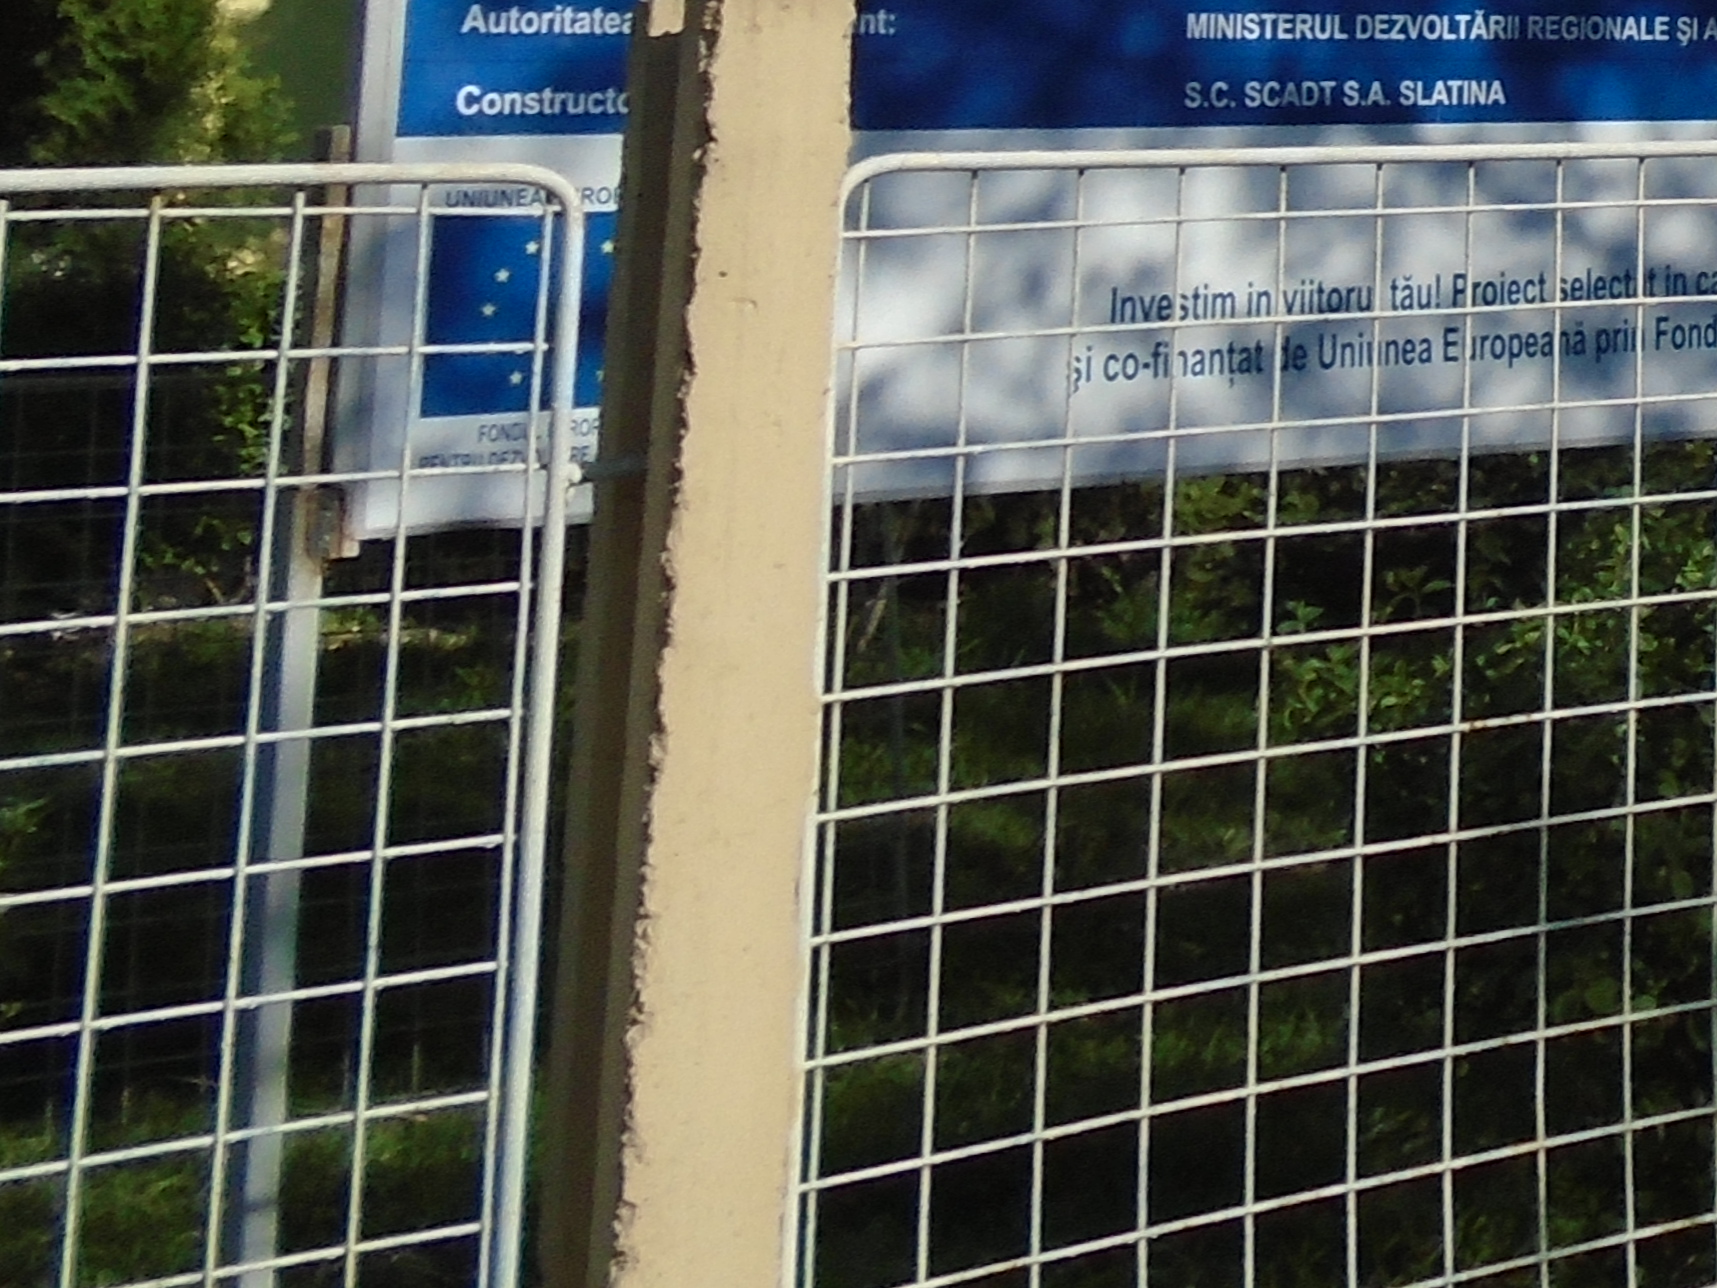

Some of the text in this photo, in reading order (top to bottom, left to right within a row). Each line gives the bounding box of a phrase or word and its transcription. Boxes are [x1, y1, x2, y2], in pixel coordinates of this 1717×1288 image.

[1186, 12, 1348, 41] MINISTERUL
[1355, 8, 1519, 41] DEZVOLTĂRII
[1528, 16, 1669, 41] REGIONALE
[456, 85, 629, 115] Constructo
[1184, 79, 1506, 108] S.C. SCADT S.A. SLATINA
[1110, 283, 1236, 323] Investim
[1283, 278, 1378, 315] viitoru
[1390, 274, 1441, 311] tău!
[1452, 271, 1546, 307] Proiect
[1279, 335, 1307, 371] de
